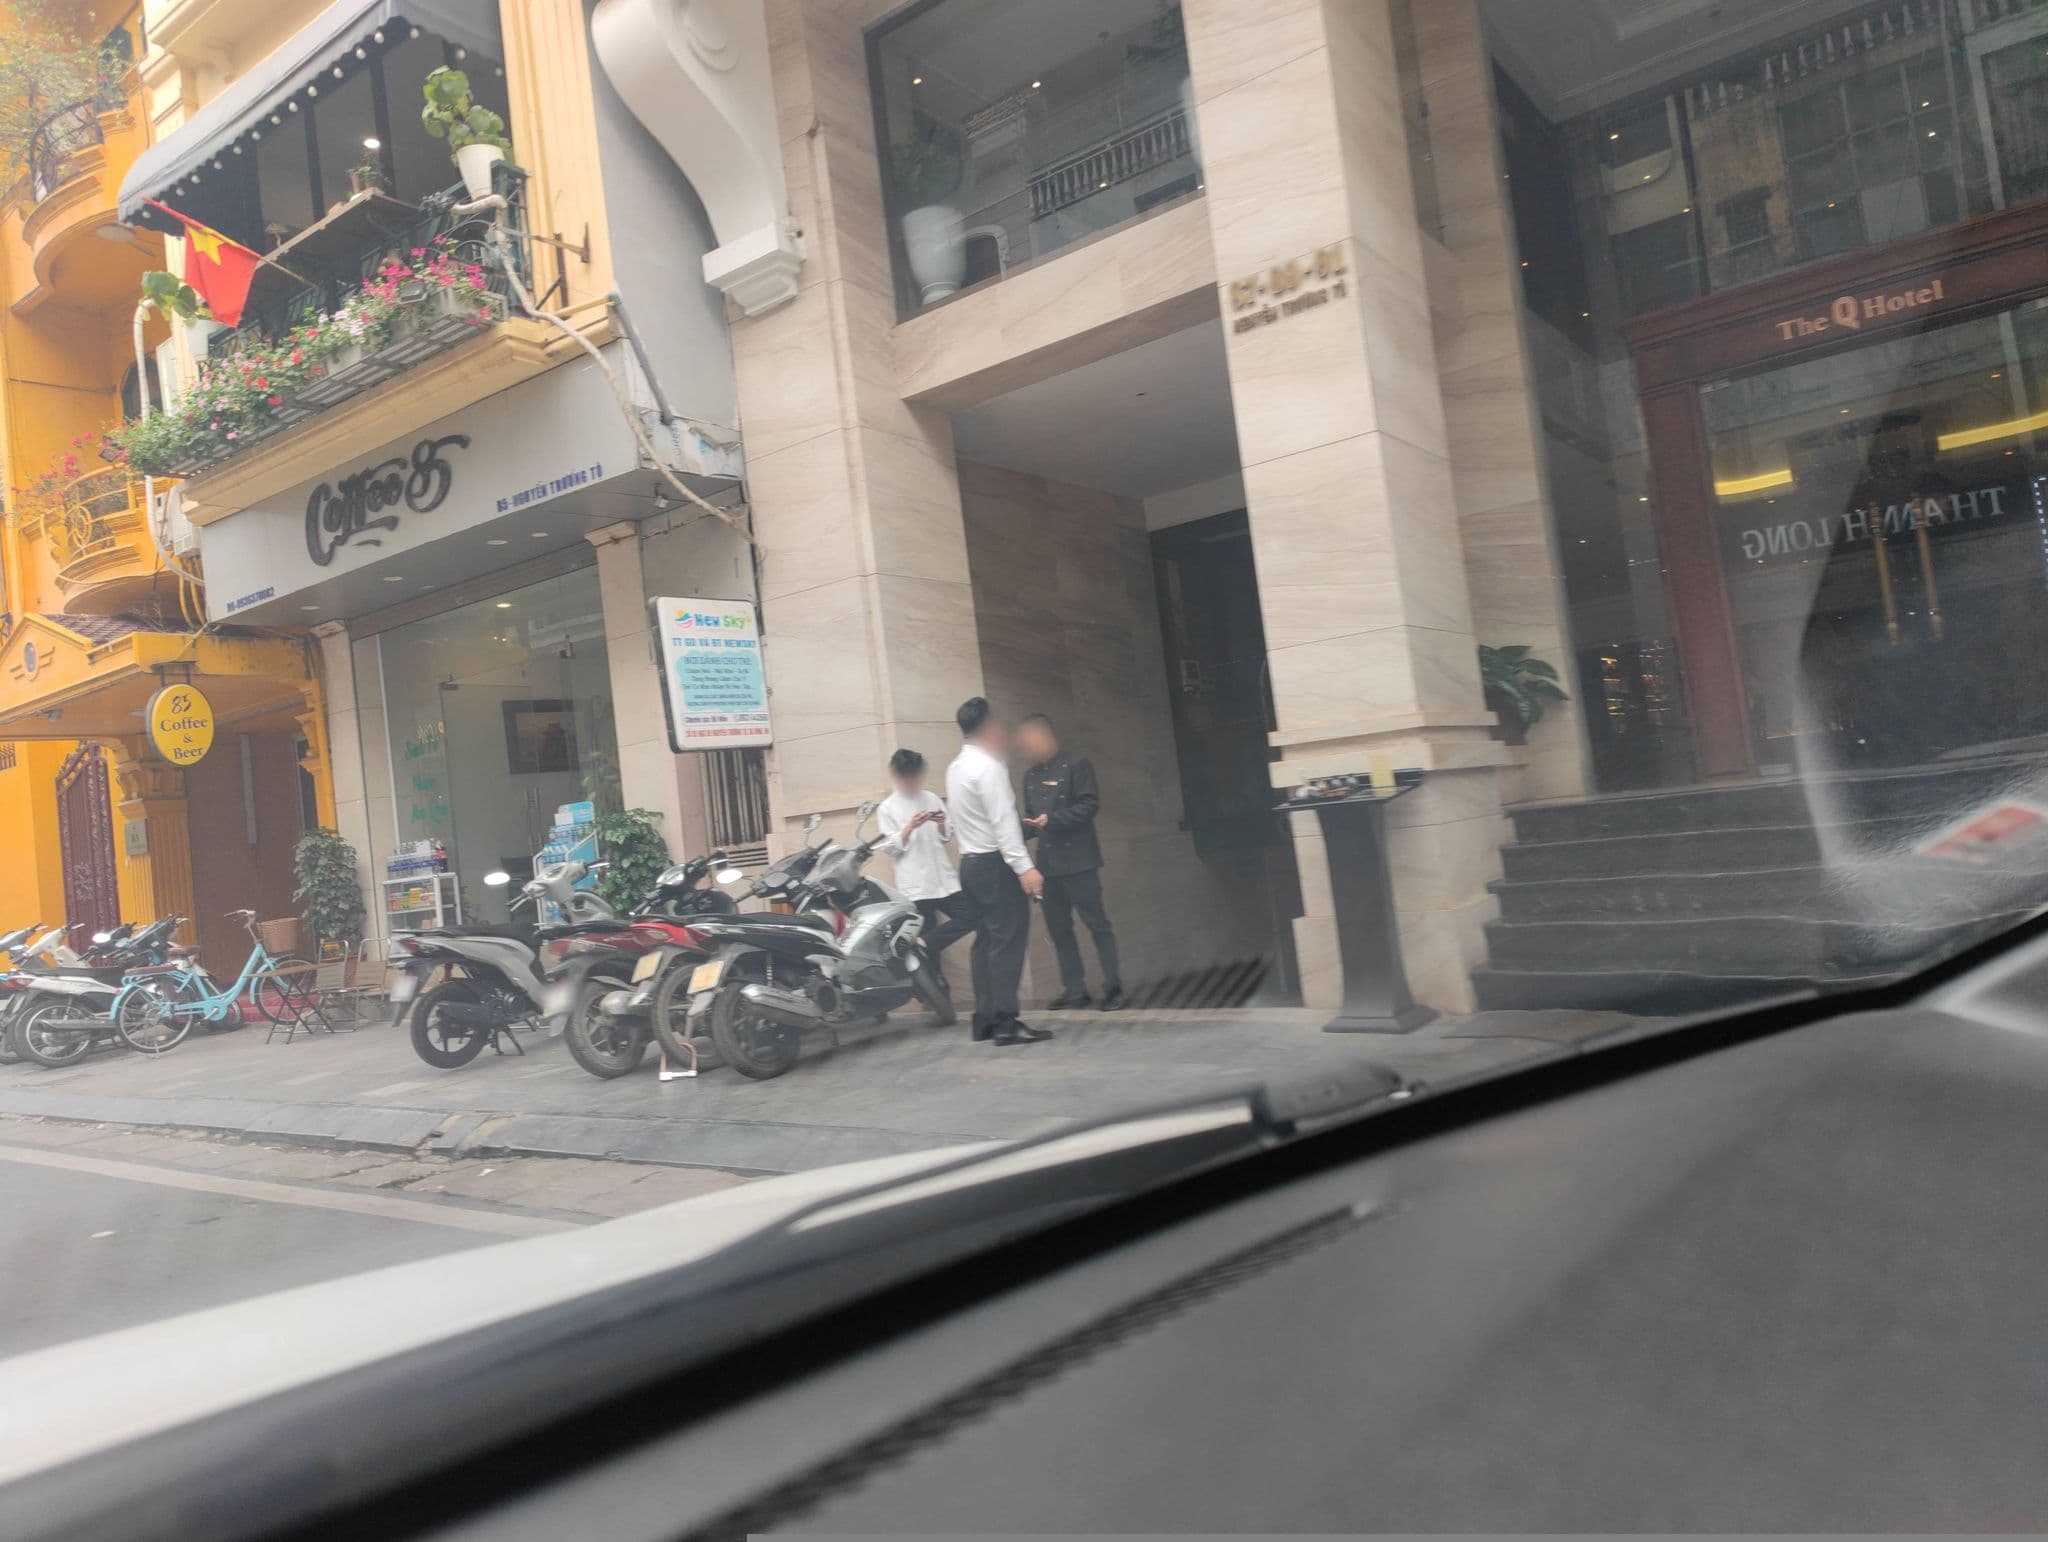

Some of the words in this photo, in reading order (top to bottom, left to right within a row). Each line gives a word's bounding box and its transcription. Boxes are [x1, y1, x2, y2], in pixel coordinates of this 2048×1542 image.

[1776, 316, 1830, 341] The
[1831, 296, 1862, 330] Q
[1863, 279, 1945, 319] Hotel
[694, 613, 720, 628] New
[160, 716, 208, 732] Coffee
[173, 747, 203, 760] Beer
